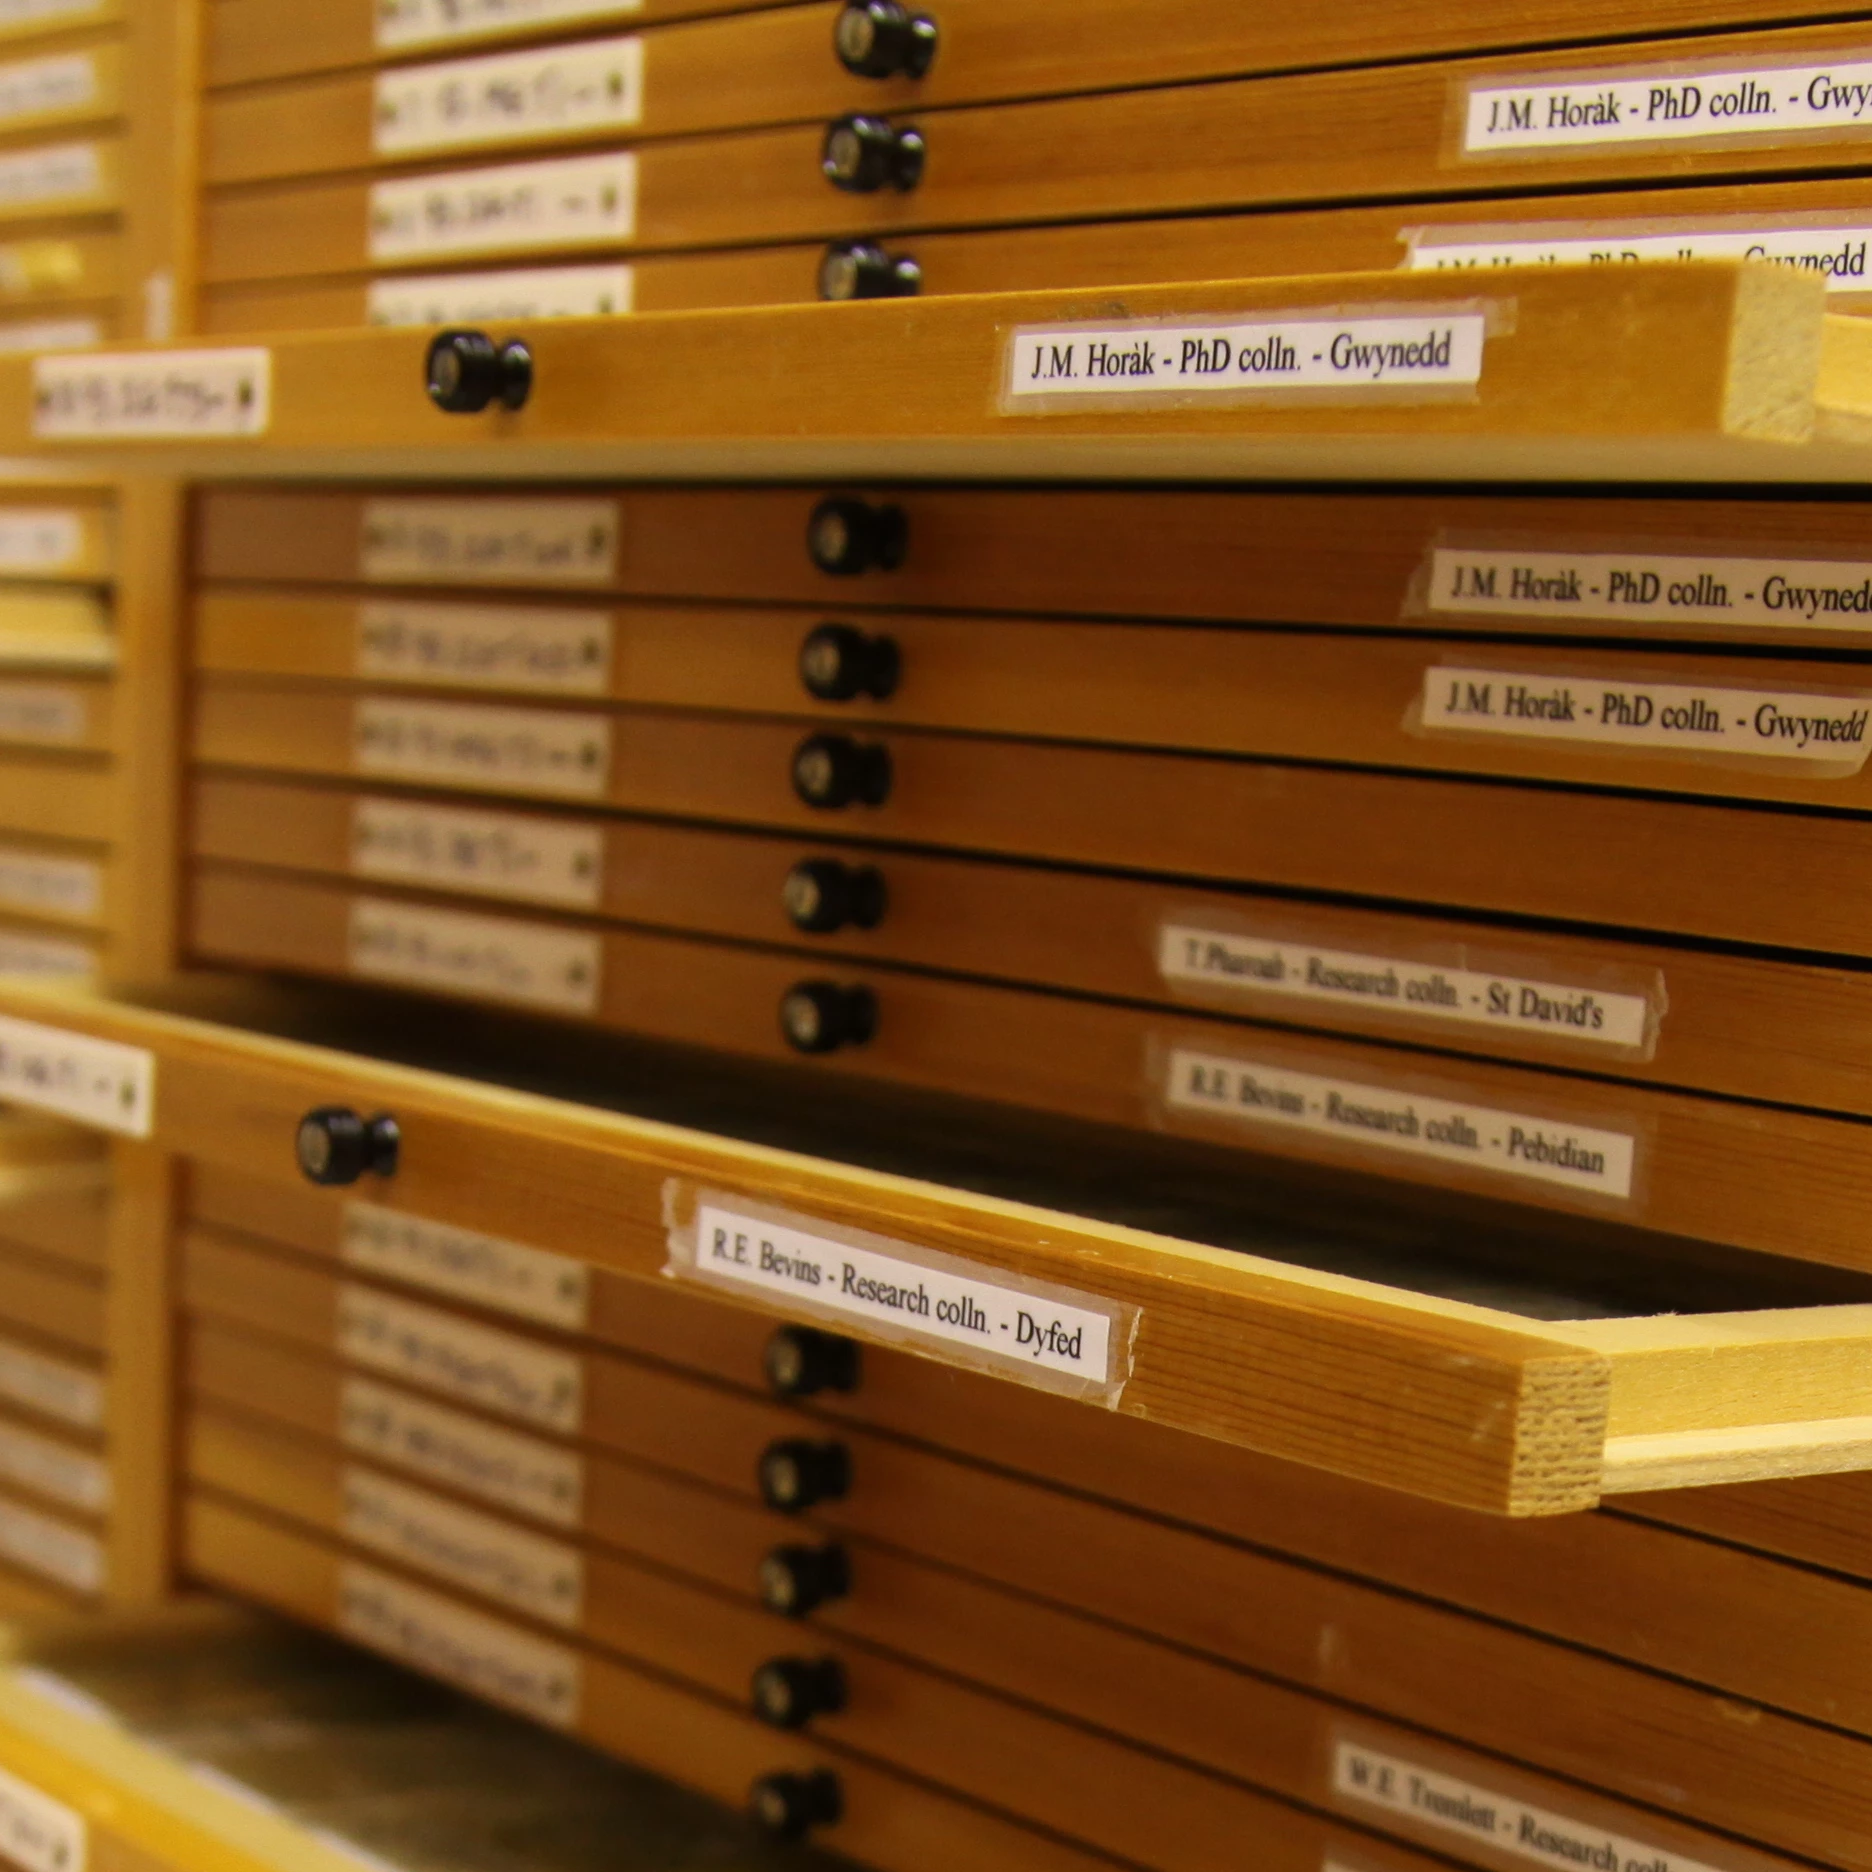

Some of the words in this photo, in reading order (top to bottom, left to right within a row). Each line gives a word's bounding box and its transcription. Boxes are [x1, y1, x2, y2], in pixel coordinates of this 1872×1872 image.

[1487, 100, 1537, 132] J.M.
[1646, 86, 1701, 121] PhD
[1709, 82, 1776, 117] colln.
[1031, 345, 1077, 379] J.M.
[1179, 338, 1230, 374] PhD
[1238, 337, 1301, 371] colln.
[1330, 330, 1452, 377] Gwynedd
[1451, 566, 1499, 598] J.M.
[1607, 571, 1660, 605] PhD
[1667, 575, 1732, 608] colln.
[1446, 681, 1496, 716] J.M.
[1600, 693, 1653, 727] PhD
[1661, 698, 1724, 733] colln.
[1754, 704, 1869, 749] Gwynedd
[1307, 958, 1398, 997] Research
[1487, 982, 1509, 1015] St
[1519, 987, 1603, 1029] David's
[1240, 1074, 1304, 1115] Bevins
[1324, 1092, 1418, 1136] Research
[1426, 1113, 1481, 1149] colln.
[1508, 1126, 1603, 1174] Pebidian
[712, 1228, 751, 1265] R.E.
[760, 1240, 821, 1285] Bevins
[842, 1263, 928, 1316] Research
[936, 1292, 991, 1334] colln.
[1016, 1312, 1082, 1359] Dyfed
[1408, 1776, 1495, 1832] Tremlett
[1520, 1816, 1618, 1872] Research
